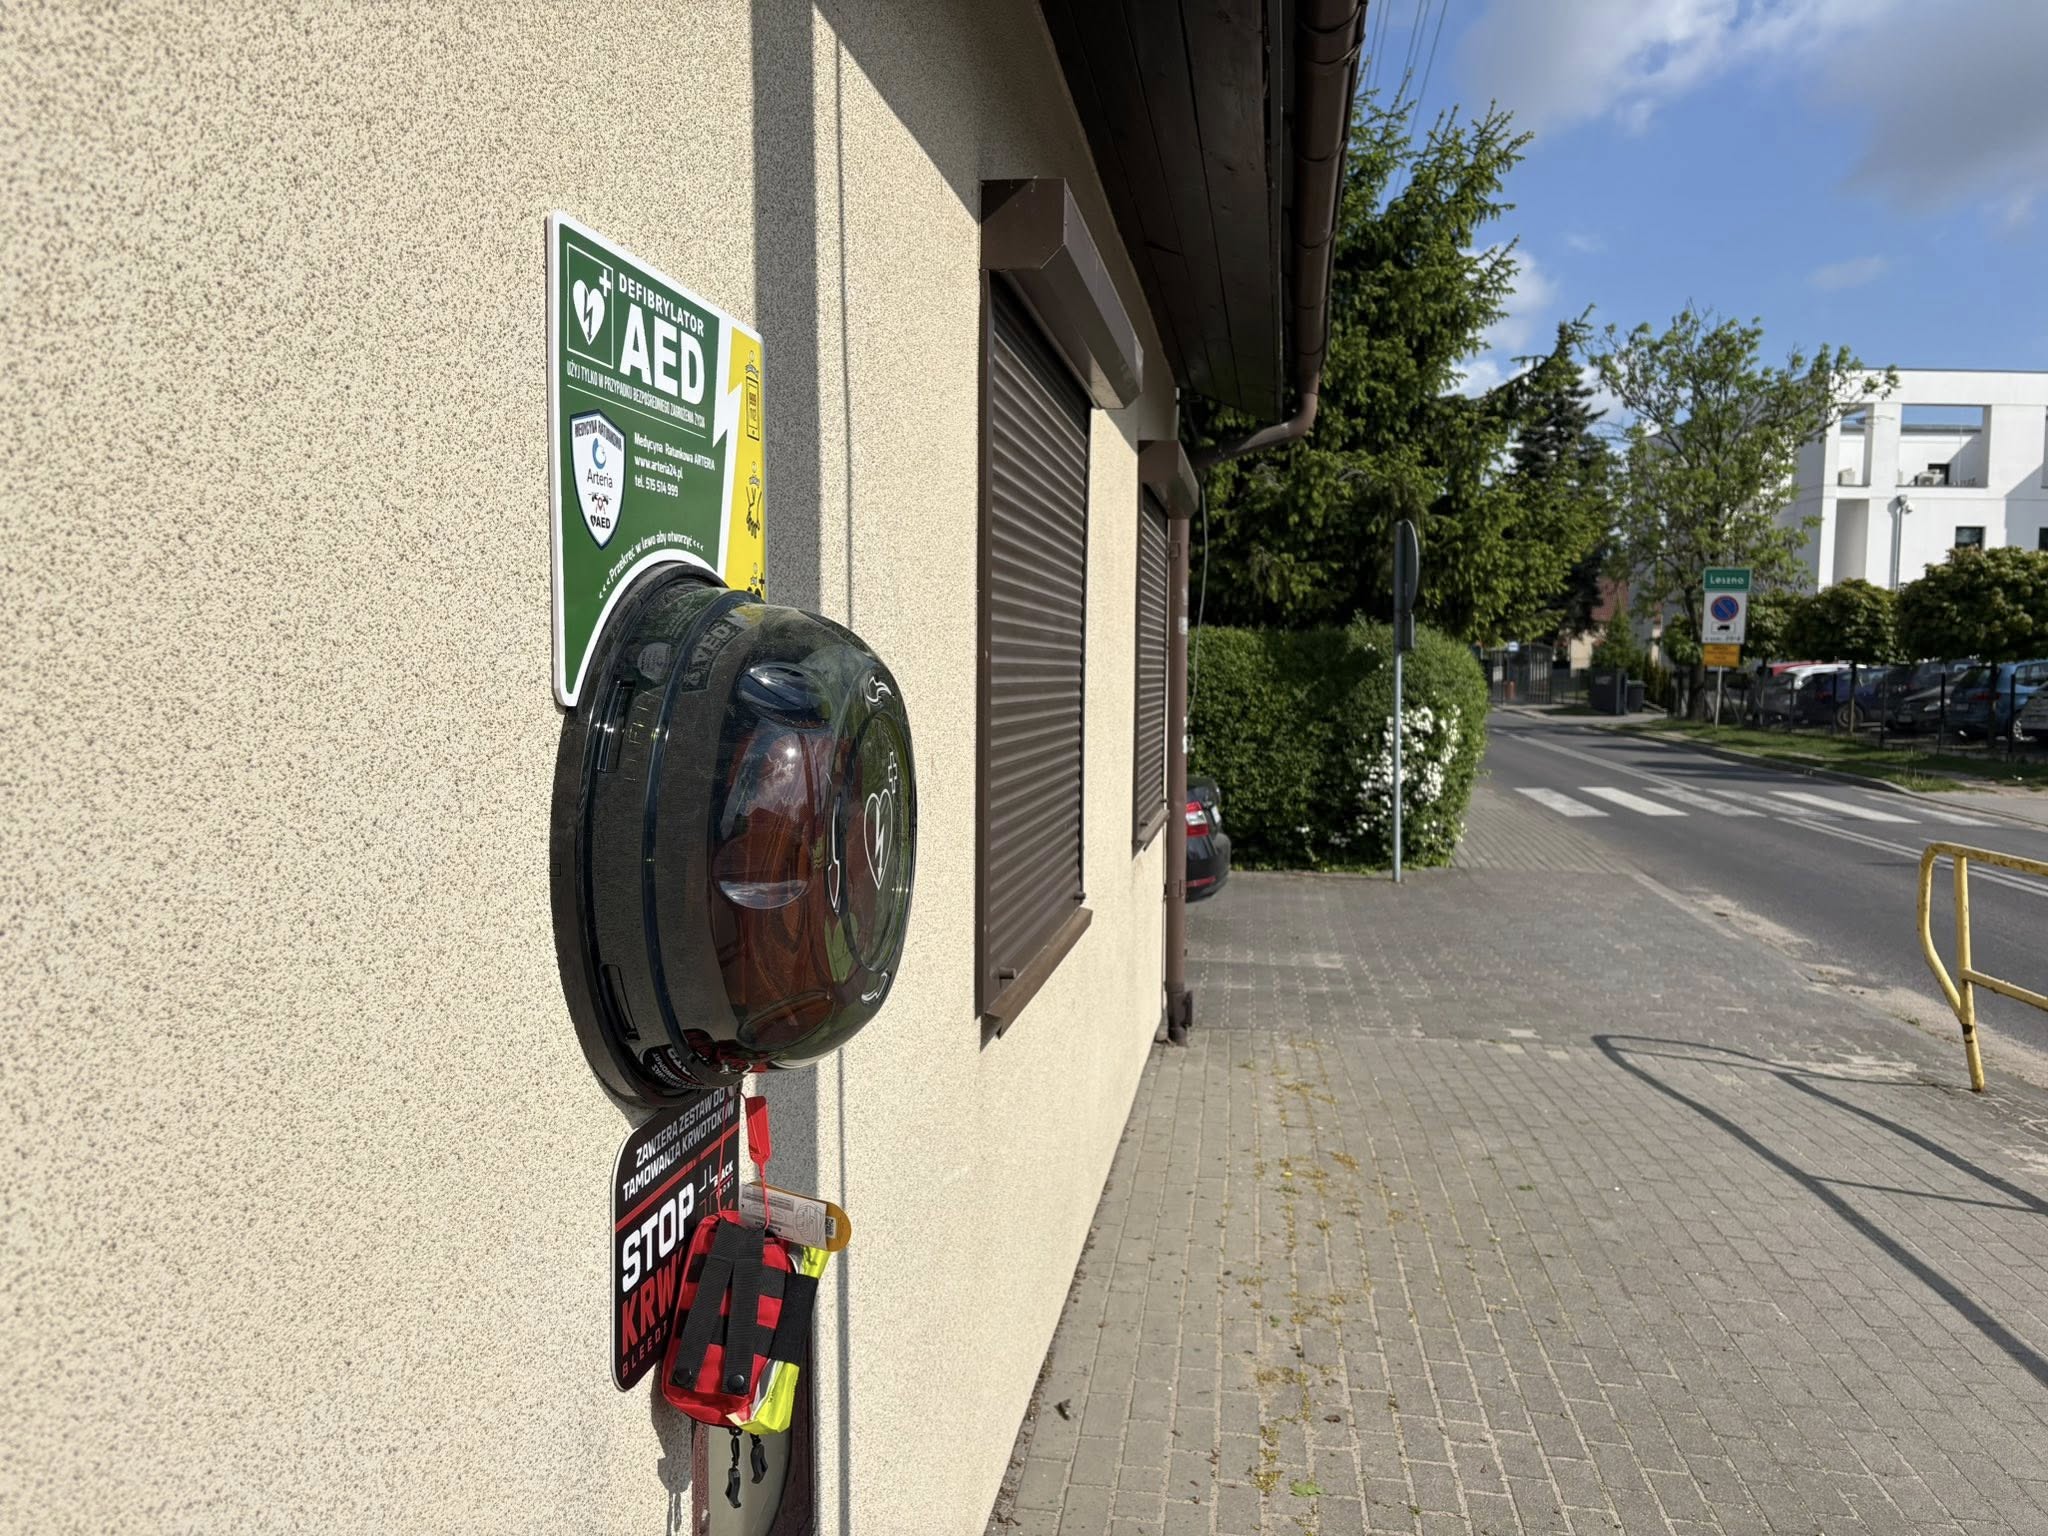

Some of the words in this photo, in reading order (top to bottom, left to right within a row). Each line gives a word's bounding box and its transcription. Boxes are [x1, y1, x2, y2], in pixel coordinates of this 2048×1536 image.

[619, 272, 704, 337] DEFIBRYLATOR
[619, 303, 705, 405] AED
[566, 359, 580, 379] UŻYJ
[581, 366, 598, 386] TYLKO
[598, 372, 604, 388] W
[604, 374, 632, 400] PRZYPADKU
[634, 432, 663, 455] Medycyna
[665, 442, 693, 464] Ratunkowa
[694, 453, 715, 471] ARTERIA
[634, 456, 683, 482] www.arteria24.pl
[586, 468, 613, 489] Arteria
[634, 474, 645, 488] tel.
[667, 483, 678, 497] 999
[596, 516, 611, 529] AED
[608, 545, 636, 582] Przekręć
[635, 542, 641, 554] w
[641, 536, 656, 549] lewo
[656, 530, 666, 546] aby
[1710, 575, 1744, 585] Leszno
[636, 1120, 678, 1168] ZAWIERA
[679, 1094, 713, 1134] ZESTAW
[713, 1086, 725, 1107] DO
[622, 1141, 681, 1201] TAMOWANIA
[714, 1160, 734, 1187] BACK
[622, 1182, 695, 1293] STOP
[622, 1247, 682, 1356] KRW
